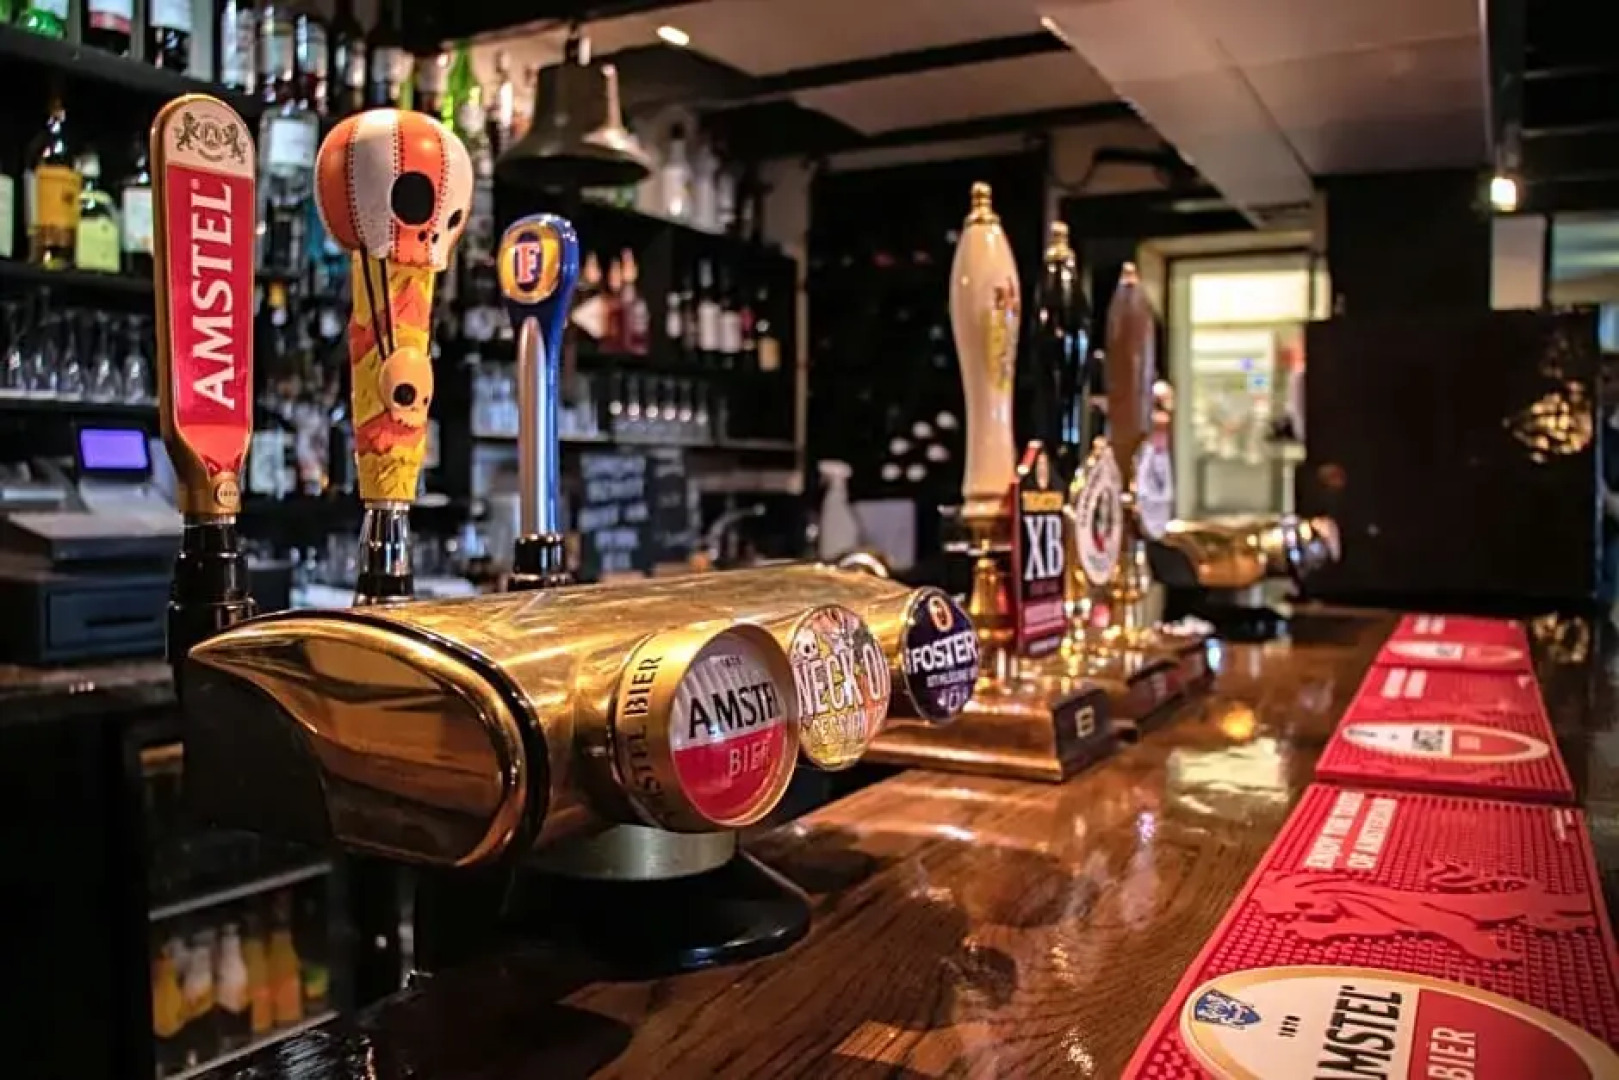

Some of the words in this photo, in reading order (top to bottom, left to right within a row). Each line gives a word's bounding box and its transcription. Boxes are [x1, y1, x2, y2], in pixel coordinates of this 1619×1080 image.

[515, 242, 540, 283] F
[190, 183, 236, 411] AMSTEL
[1022, 514, 1065, 581] XB
[624, 657, 662, 717] BIER
[793, 652, 863, 719] NECK
[1313, 990, 1402, 1080] MSTEL
[1427, 1026, 1476, 1080] BIER
